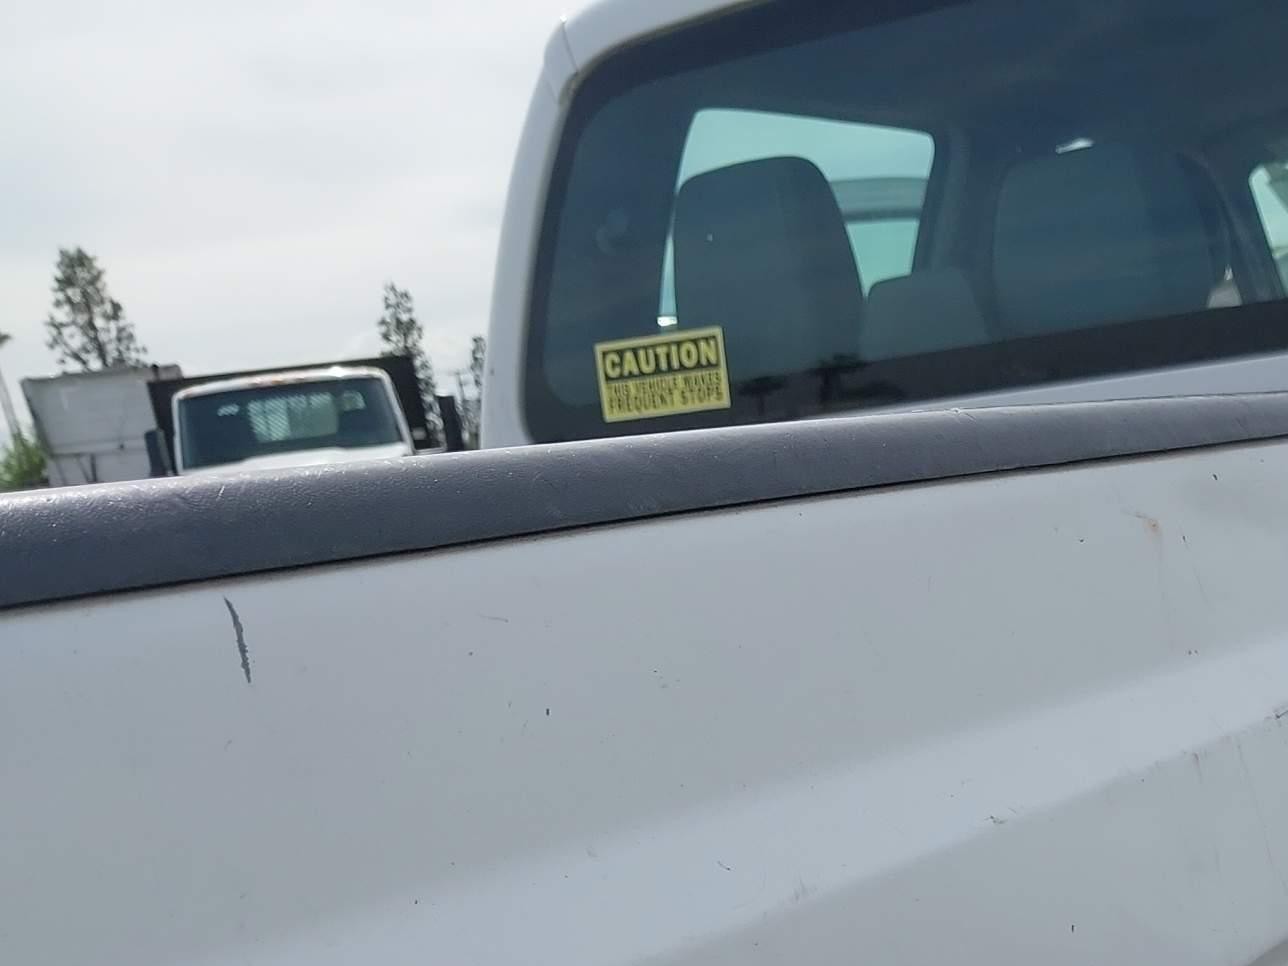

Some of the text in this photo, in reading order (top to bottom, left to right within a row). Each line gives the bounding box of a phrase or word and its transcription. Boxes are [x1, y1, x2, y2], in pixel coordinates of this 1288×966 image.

[605, 338, 717, 378] CAUTION
[606, 371, 721, 396] THIS VEHICLE MAKES
[608, 385, 723, 414] FREQUENT STOPS
